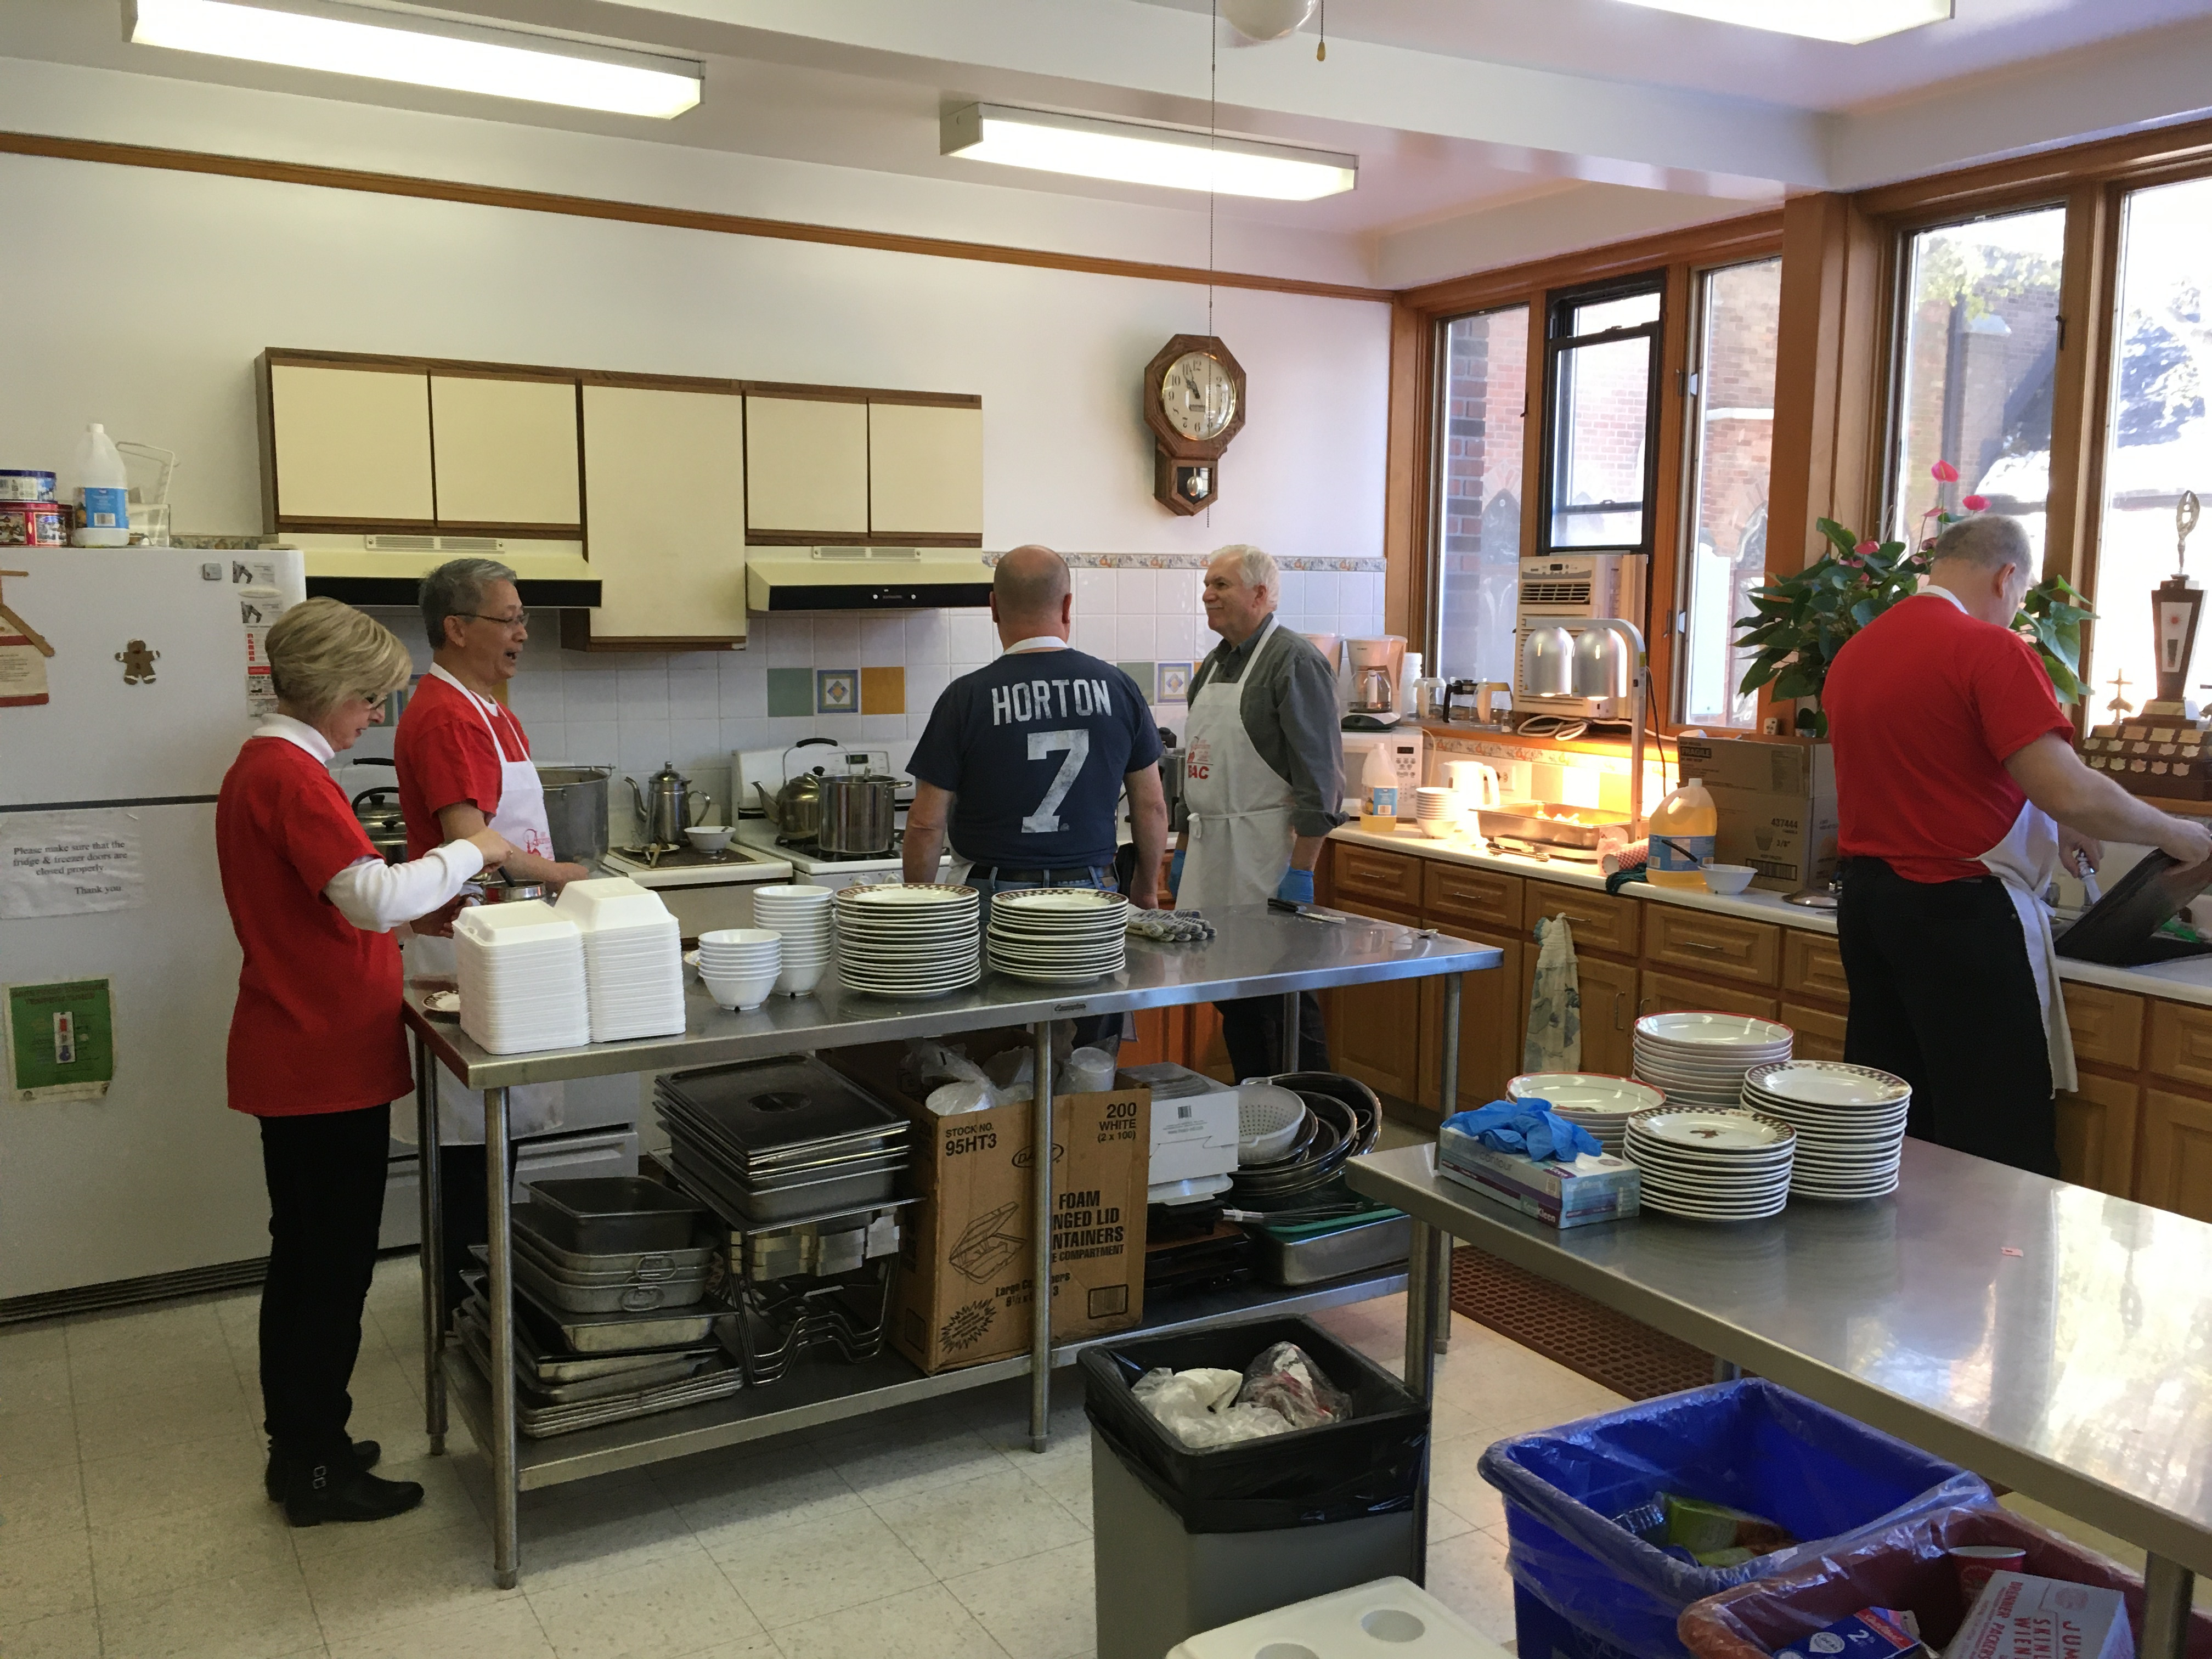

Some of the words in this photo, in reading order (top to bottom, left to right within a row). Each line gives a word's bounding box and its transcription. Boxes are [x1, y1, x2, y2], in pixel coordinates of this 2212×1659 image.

[1193, 359, 1201, 371] 12
[1171, 374, 1181, 386] 10
[1168, 391, 1175, 401] 9
[1182, 416, 1188, 428] 7
[1194, 422, 1200, 432] 6
[991, 679, 1112, 726] HORTON
[1681, 747, 1711, 757] FRAGILE
[1021, 729, 1089, 833] 7
[1771, 818, 1798, 829] 437444
[44, 844, 69, 853] make
[13, 856, 40, 867] fridge
[42, 856, 50, 864] &
[54, 855, 84, 864] freezer
[87, 853, 111, 861] doors
[36, 867, 64, 876] closed
[75, 885, 102, 895] Thank
[104, 885, 121, 894] you
[1107, 1102, 1137, 1119] 200
[945, 1124, 977, 1138] STOCK
[979, 1122, 994, 1132] NO.
[1099, 1119, 1136, 1131] WHITE
[945, 1133, 997, 1156] 95HT3
[1059, 1190, 1101, 1210] FOAM
[1052, 1210, 1092, 1231] NGED
[1097, 1207, 1120, 1224] LID
[1052, 1226, 1124, 1250] NTAINERS
[1059, 1244, 1124, 1261] COMPARTMENT
[995, 1282, 1021, 1298] Large
